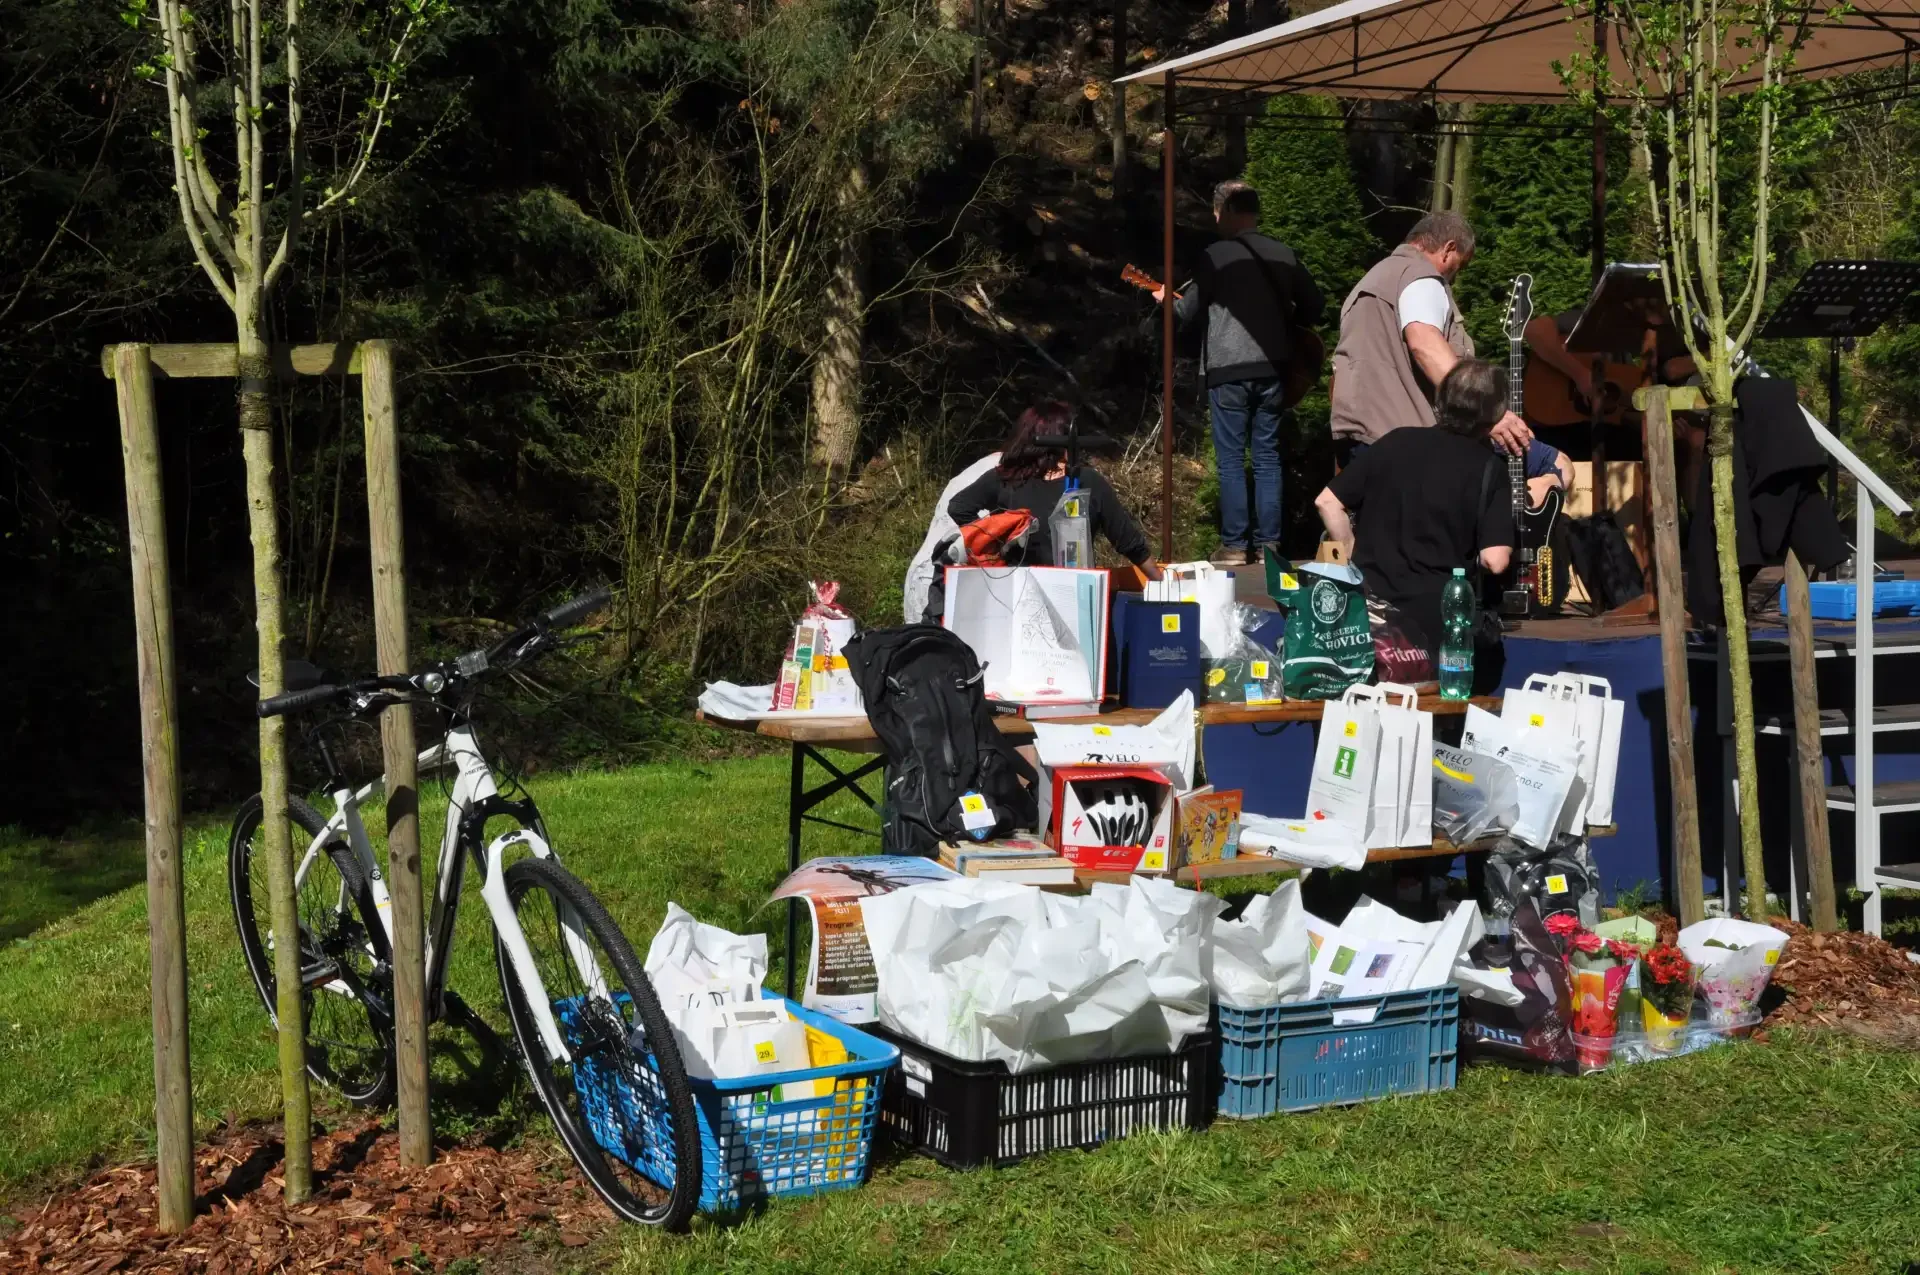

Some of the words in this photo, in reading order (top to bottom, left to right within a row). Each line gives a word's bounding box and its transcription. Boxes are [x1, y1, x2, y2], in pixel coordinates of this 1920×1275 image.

[1105, 754, 1141, 763] VELO
[824, 922, 854, 930] Program
[758, 1050, 773, 1059] 29.
